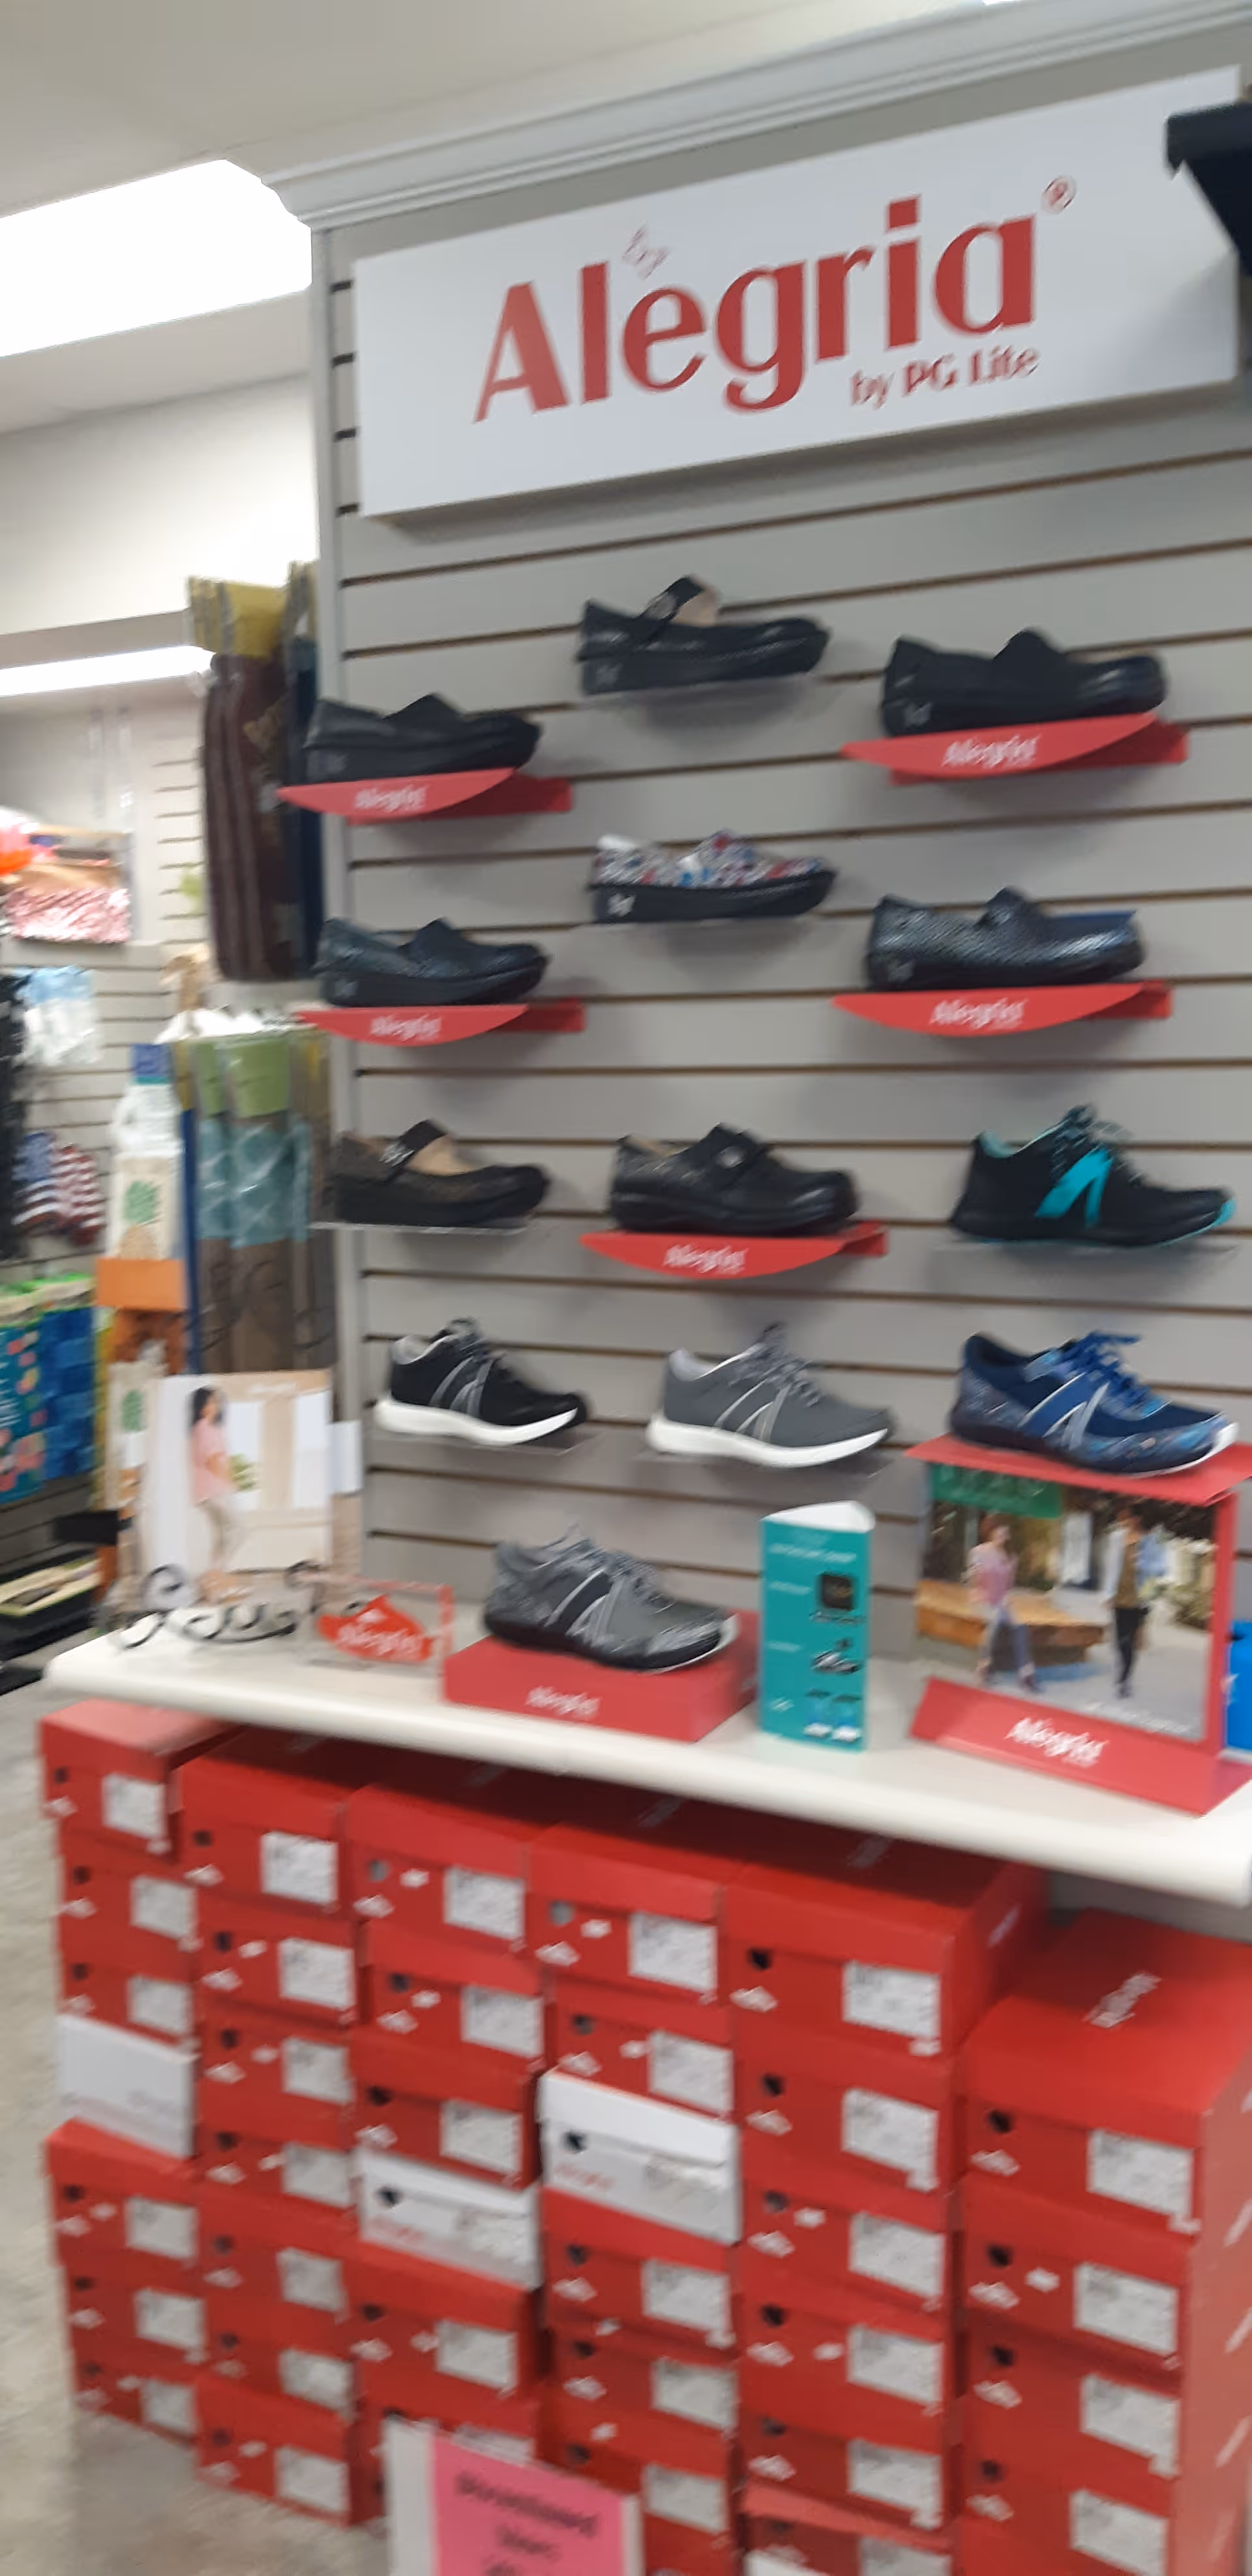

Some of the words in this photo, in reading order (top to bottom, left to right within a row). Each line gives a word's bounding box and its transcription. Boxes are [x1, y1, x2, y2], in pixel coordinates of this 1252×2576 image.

[475, 194, 1036, 422] Alegria
[850, 370, 895, 410] by
[902, 352, 959, 397] PG
[969, 345, 1041, 386] Lite
